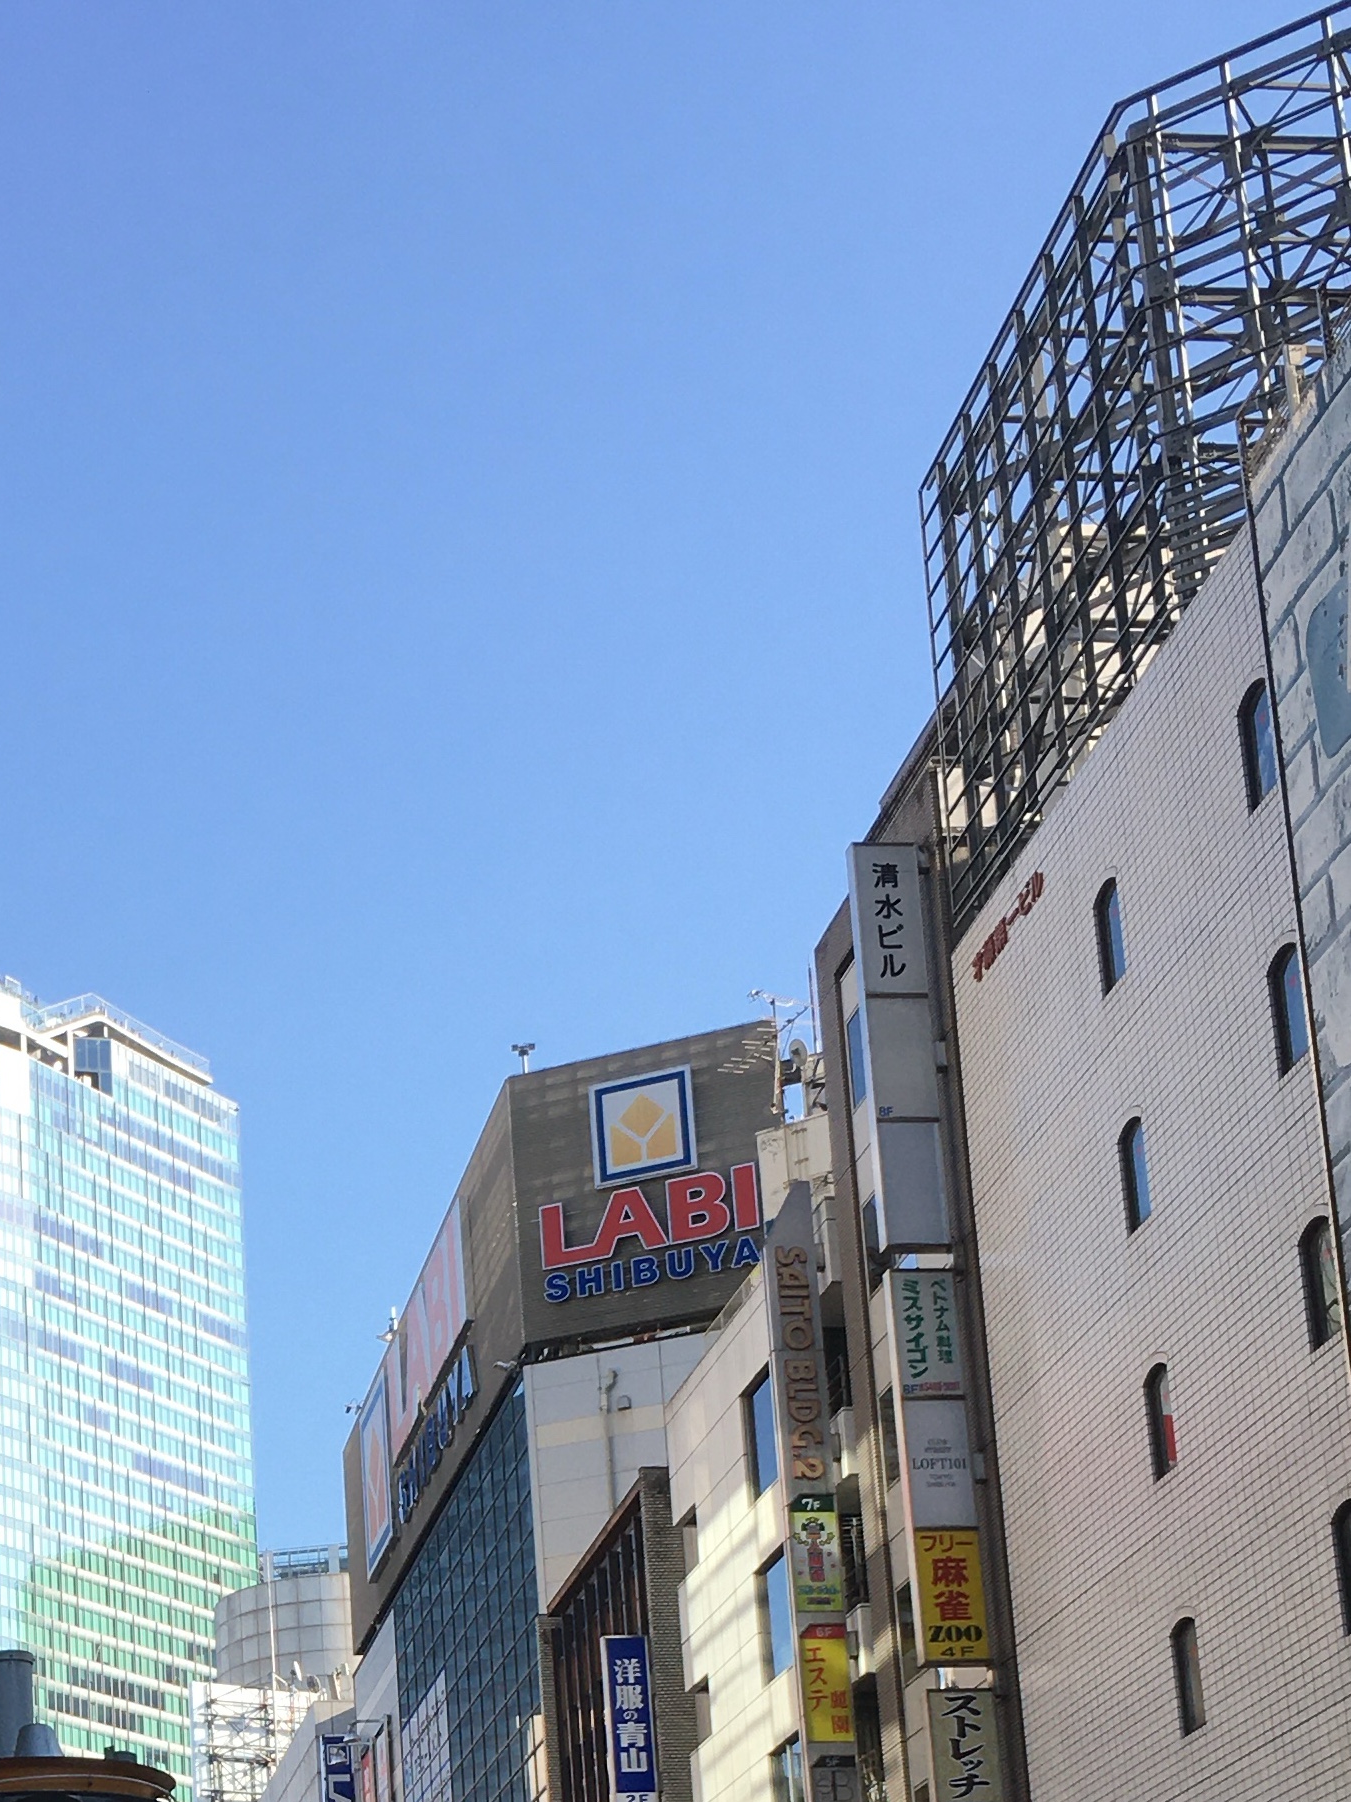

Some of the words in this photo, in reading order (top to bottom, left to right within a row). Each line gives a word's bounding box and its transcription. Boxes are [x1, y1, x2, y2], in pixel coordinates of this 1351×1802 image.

[872, 862, 906, 978] 清水ビル
[539, 1162, 760, 1271] LABI
[544, 1236, 760, 1303] SHIBUYA
[776, 1245, 814, 1351] SAITO
[386, 1203, 465, 1456] LABI
[902, 1279, 929, 1379] ミスサイゴン
[930, 1278, 953, 1364] ベトナム料理
[802, 1499, 821, 1511] 7F
[912, 1458, 966, 1470] LOFT101
[920, 1535, 973, 1553] フリー
[931, 1556, 973, 1622] 麻雀
[928, 1625, 983, 1642] ZOO
[614, 1658, 649, 1773] 洋服の青山
[804, 1647, 829, 1712] エステ
[941, 1694, 991, 1799] ストレッチ
